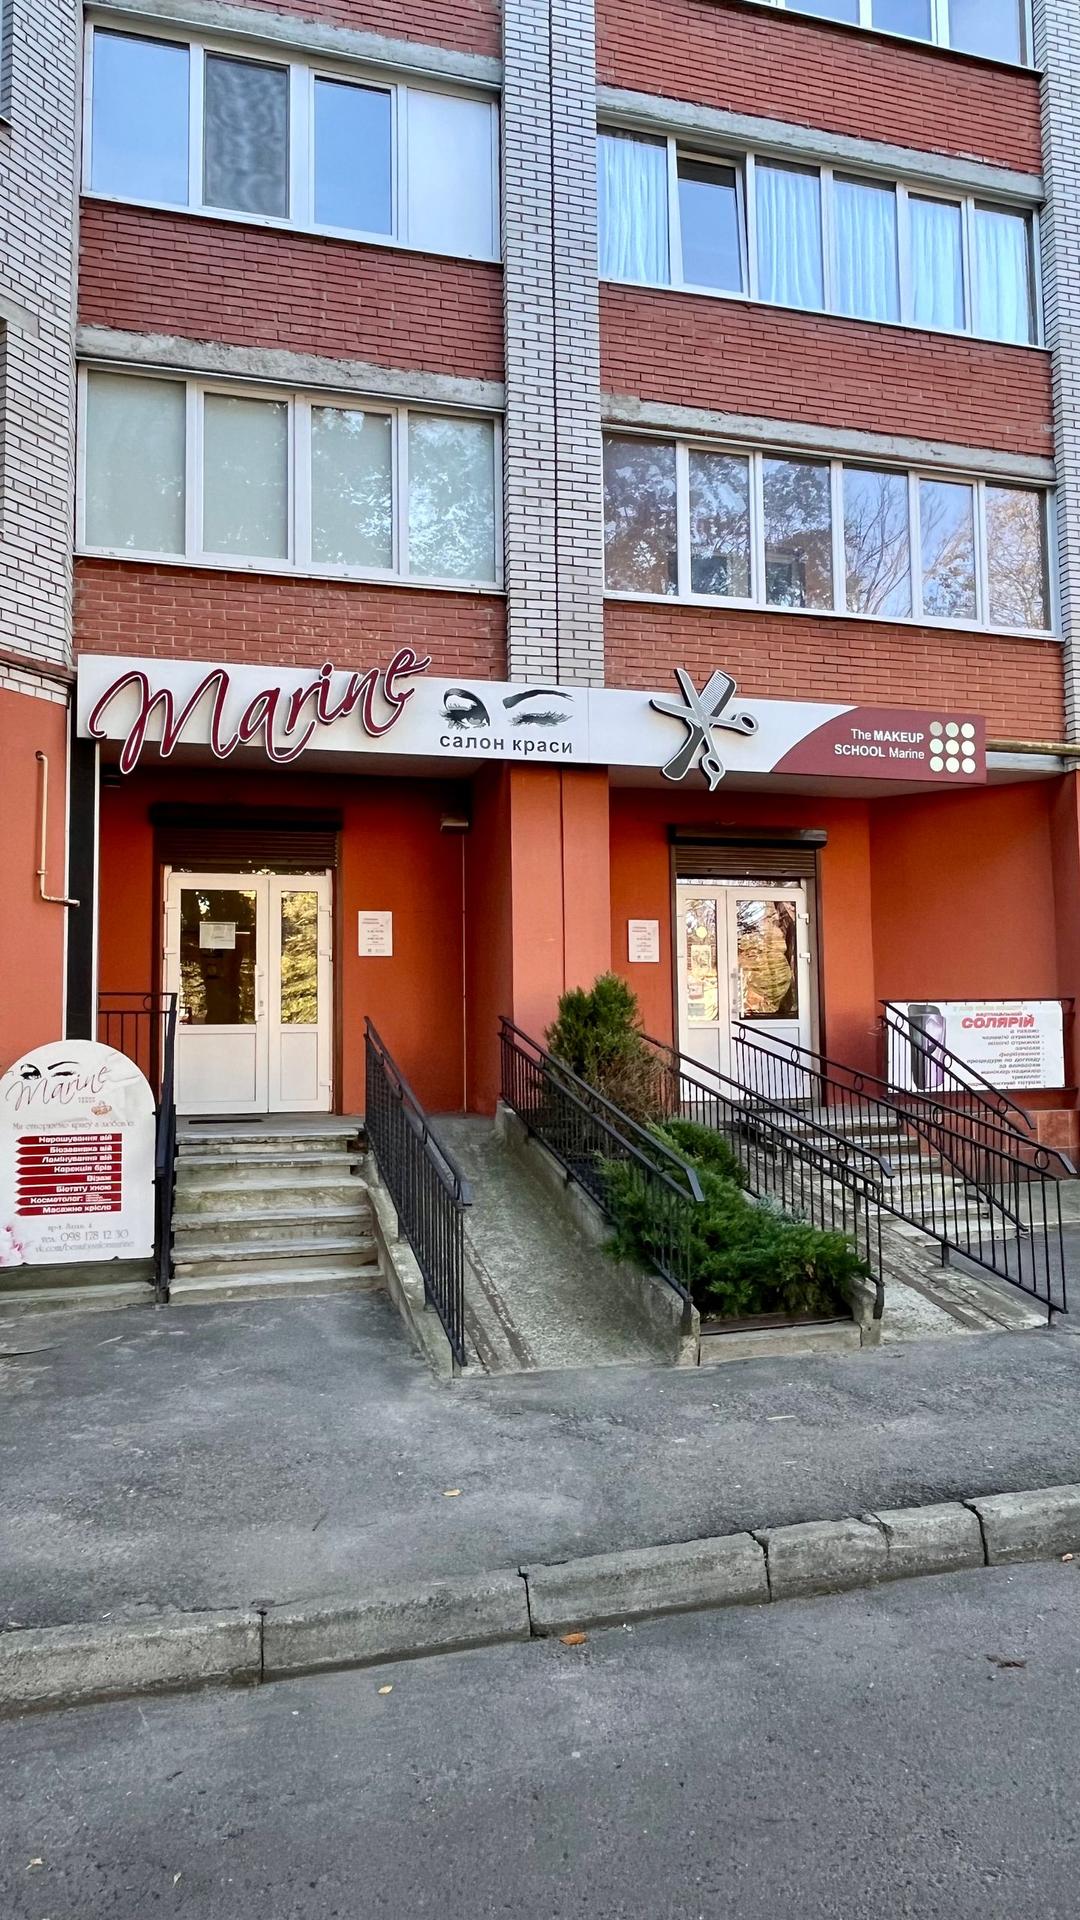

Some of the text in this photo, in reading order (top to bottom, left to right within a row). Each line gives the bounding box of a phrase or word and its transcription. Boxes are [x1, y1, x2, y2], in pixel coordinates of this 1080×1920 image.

[87, 646, 432, 775] Marine
[850, 728, 924, 743] The MAKEUP
[440, 735, 573, 755] салон краси
[834, 744, 925, 759] SCHOOL Marine
[961, 1014, 1035, 1029] СОЛЯРІЙ
[5, 1066, 111, 1111] Marine
